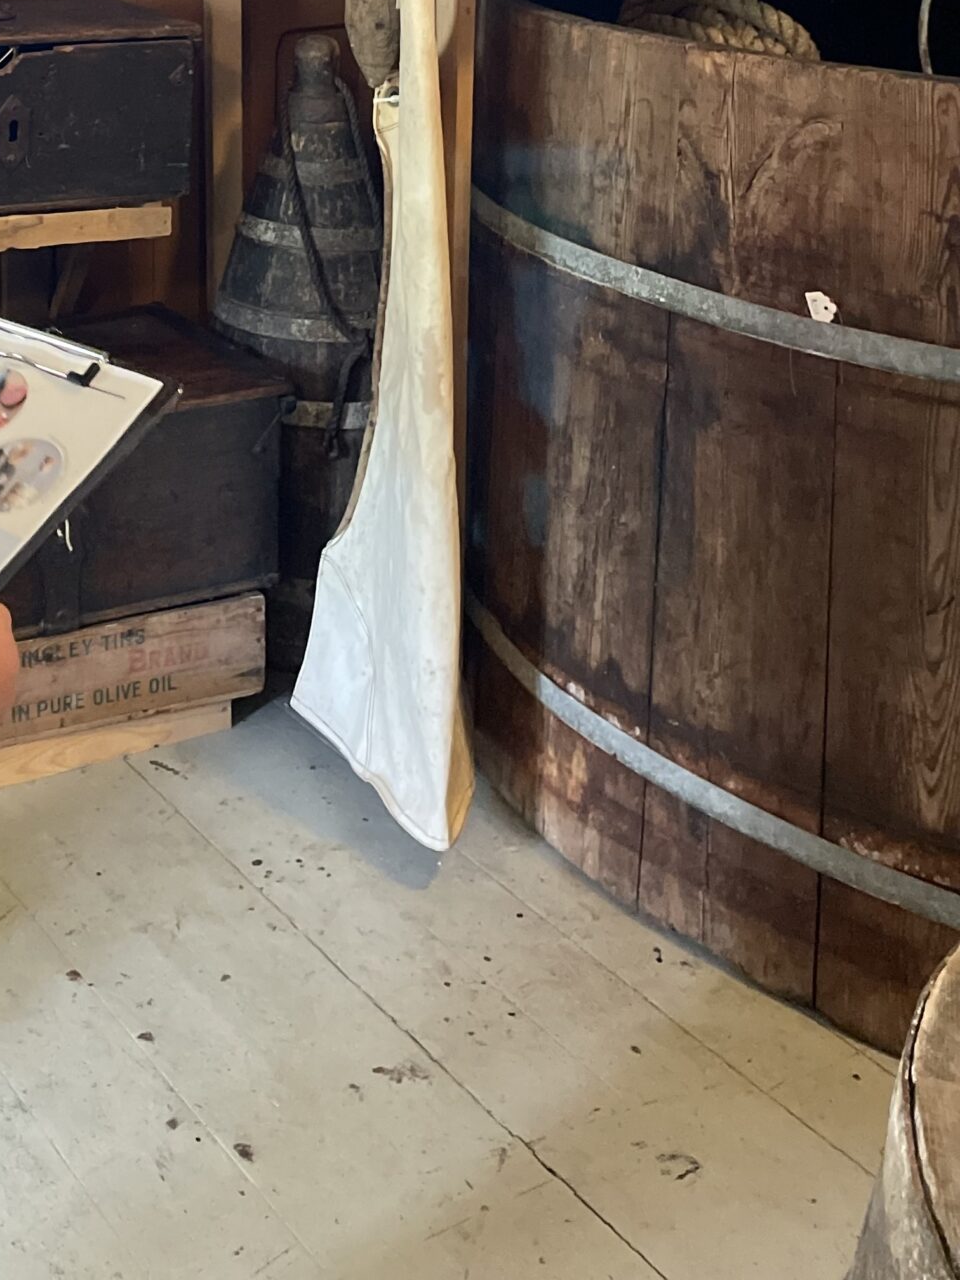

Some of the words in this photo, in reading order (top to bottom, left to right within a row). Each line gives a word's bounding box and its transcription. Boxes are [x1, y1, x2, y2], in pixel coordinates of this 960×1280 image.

[11, 704, 30, 723] IN
[36, 693, 85, 717] PURE
[93, 680, 142, 706] OLIVE
[148, 675, 177, 694] OIL
